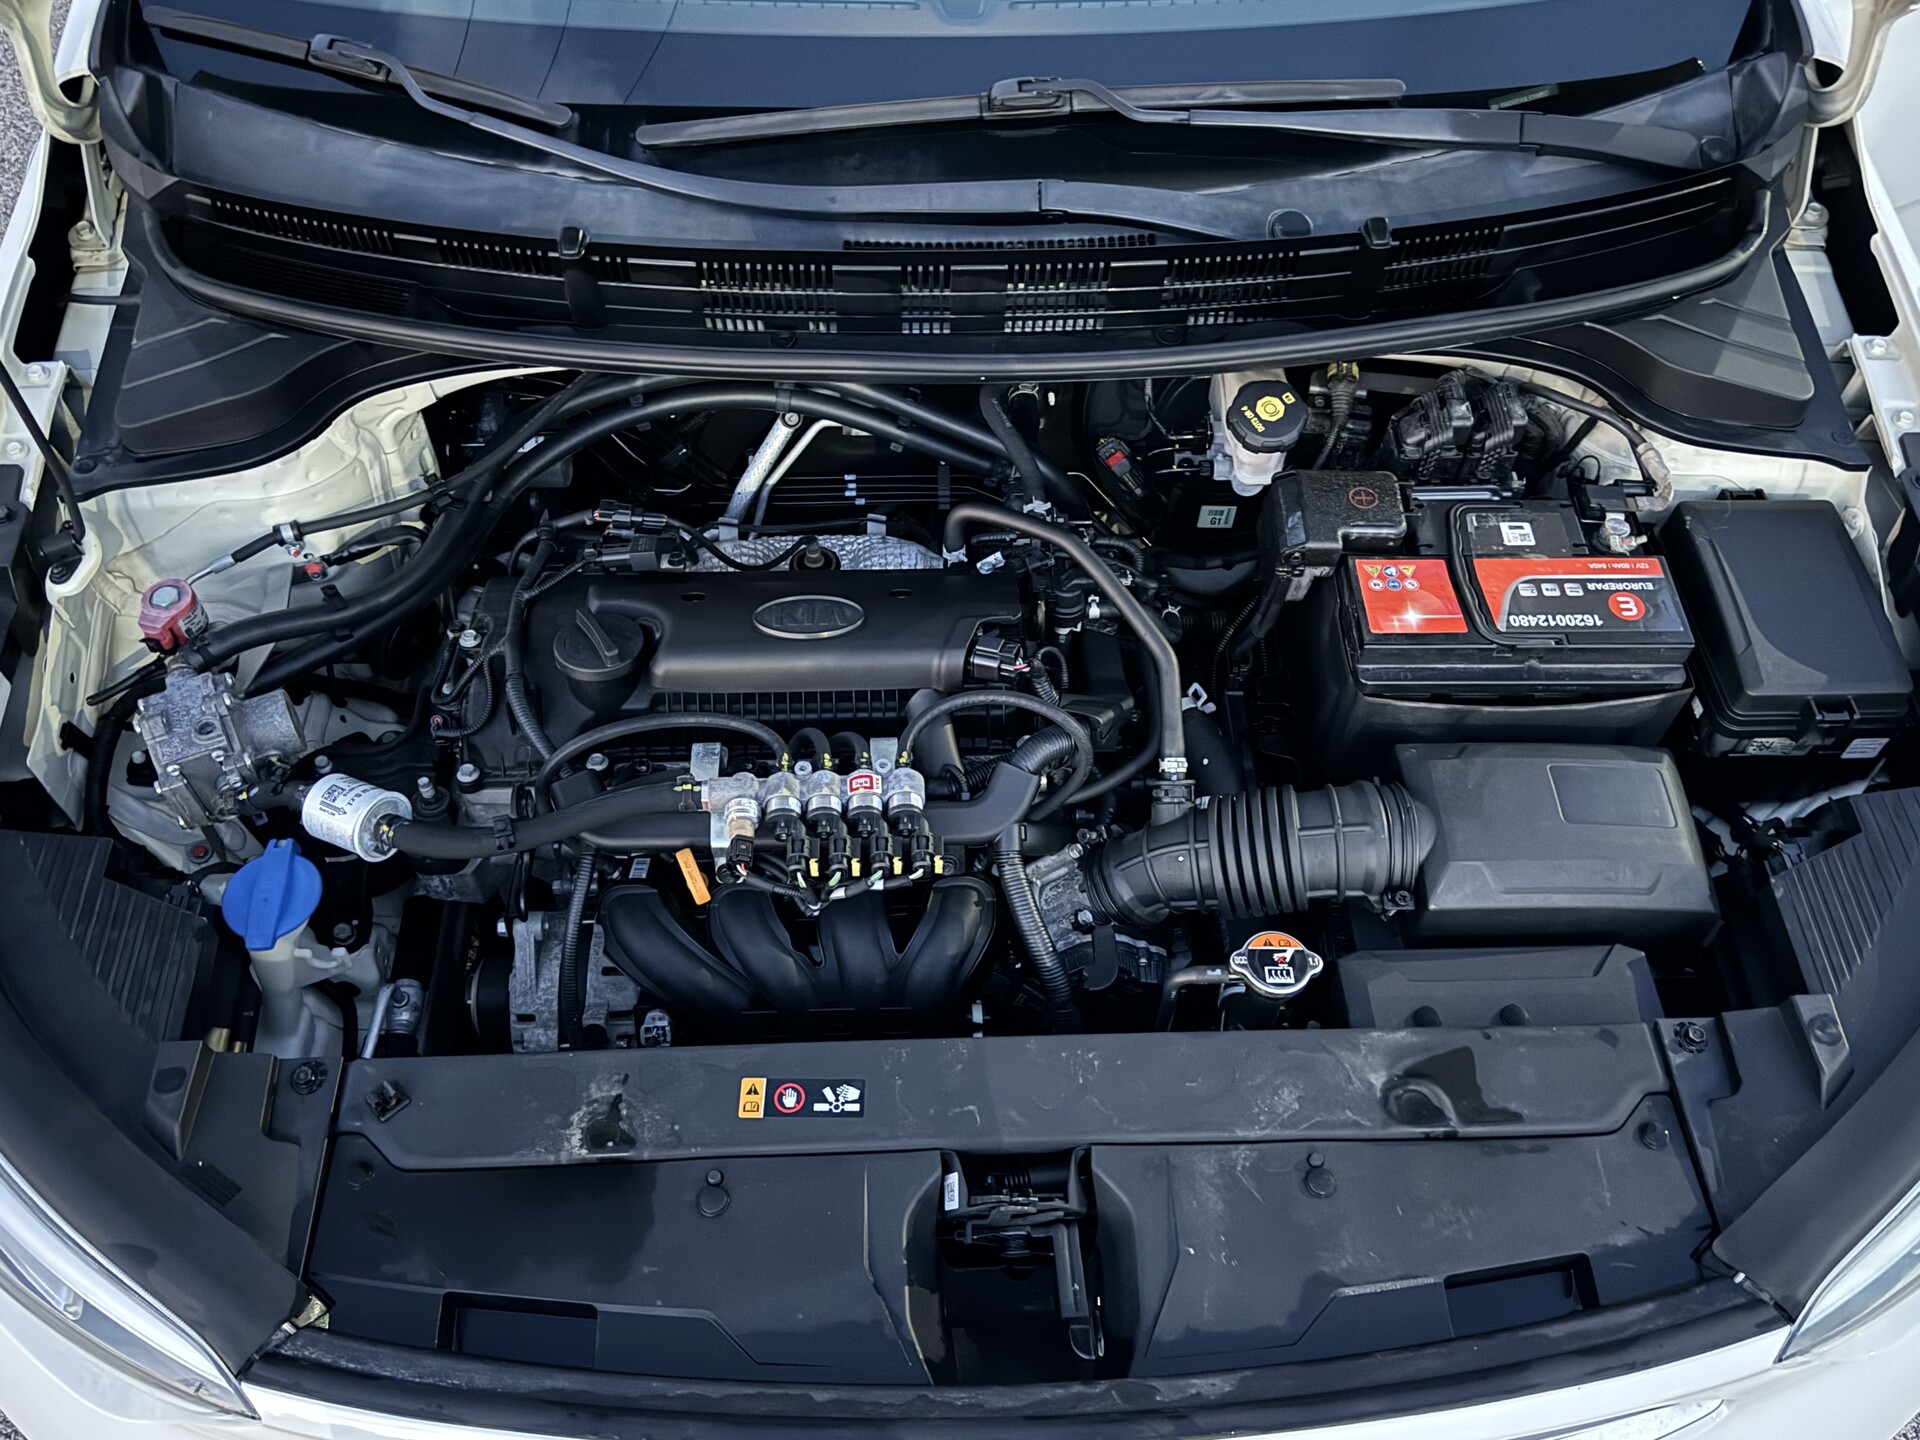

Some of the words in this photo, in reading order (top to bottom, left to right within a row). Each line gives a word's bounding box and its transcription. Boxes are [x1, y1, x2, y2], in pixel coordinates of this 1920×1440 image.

[1250, 417, 1265, 433] DOT3
[1210, 516, 1221, 526] G1
[1586, 581, 1653, 591] EUROREPAR
[772, 603, 848, 627] KIA
[1509, 614, 1604, 627] 1620012480
